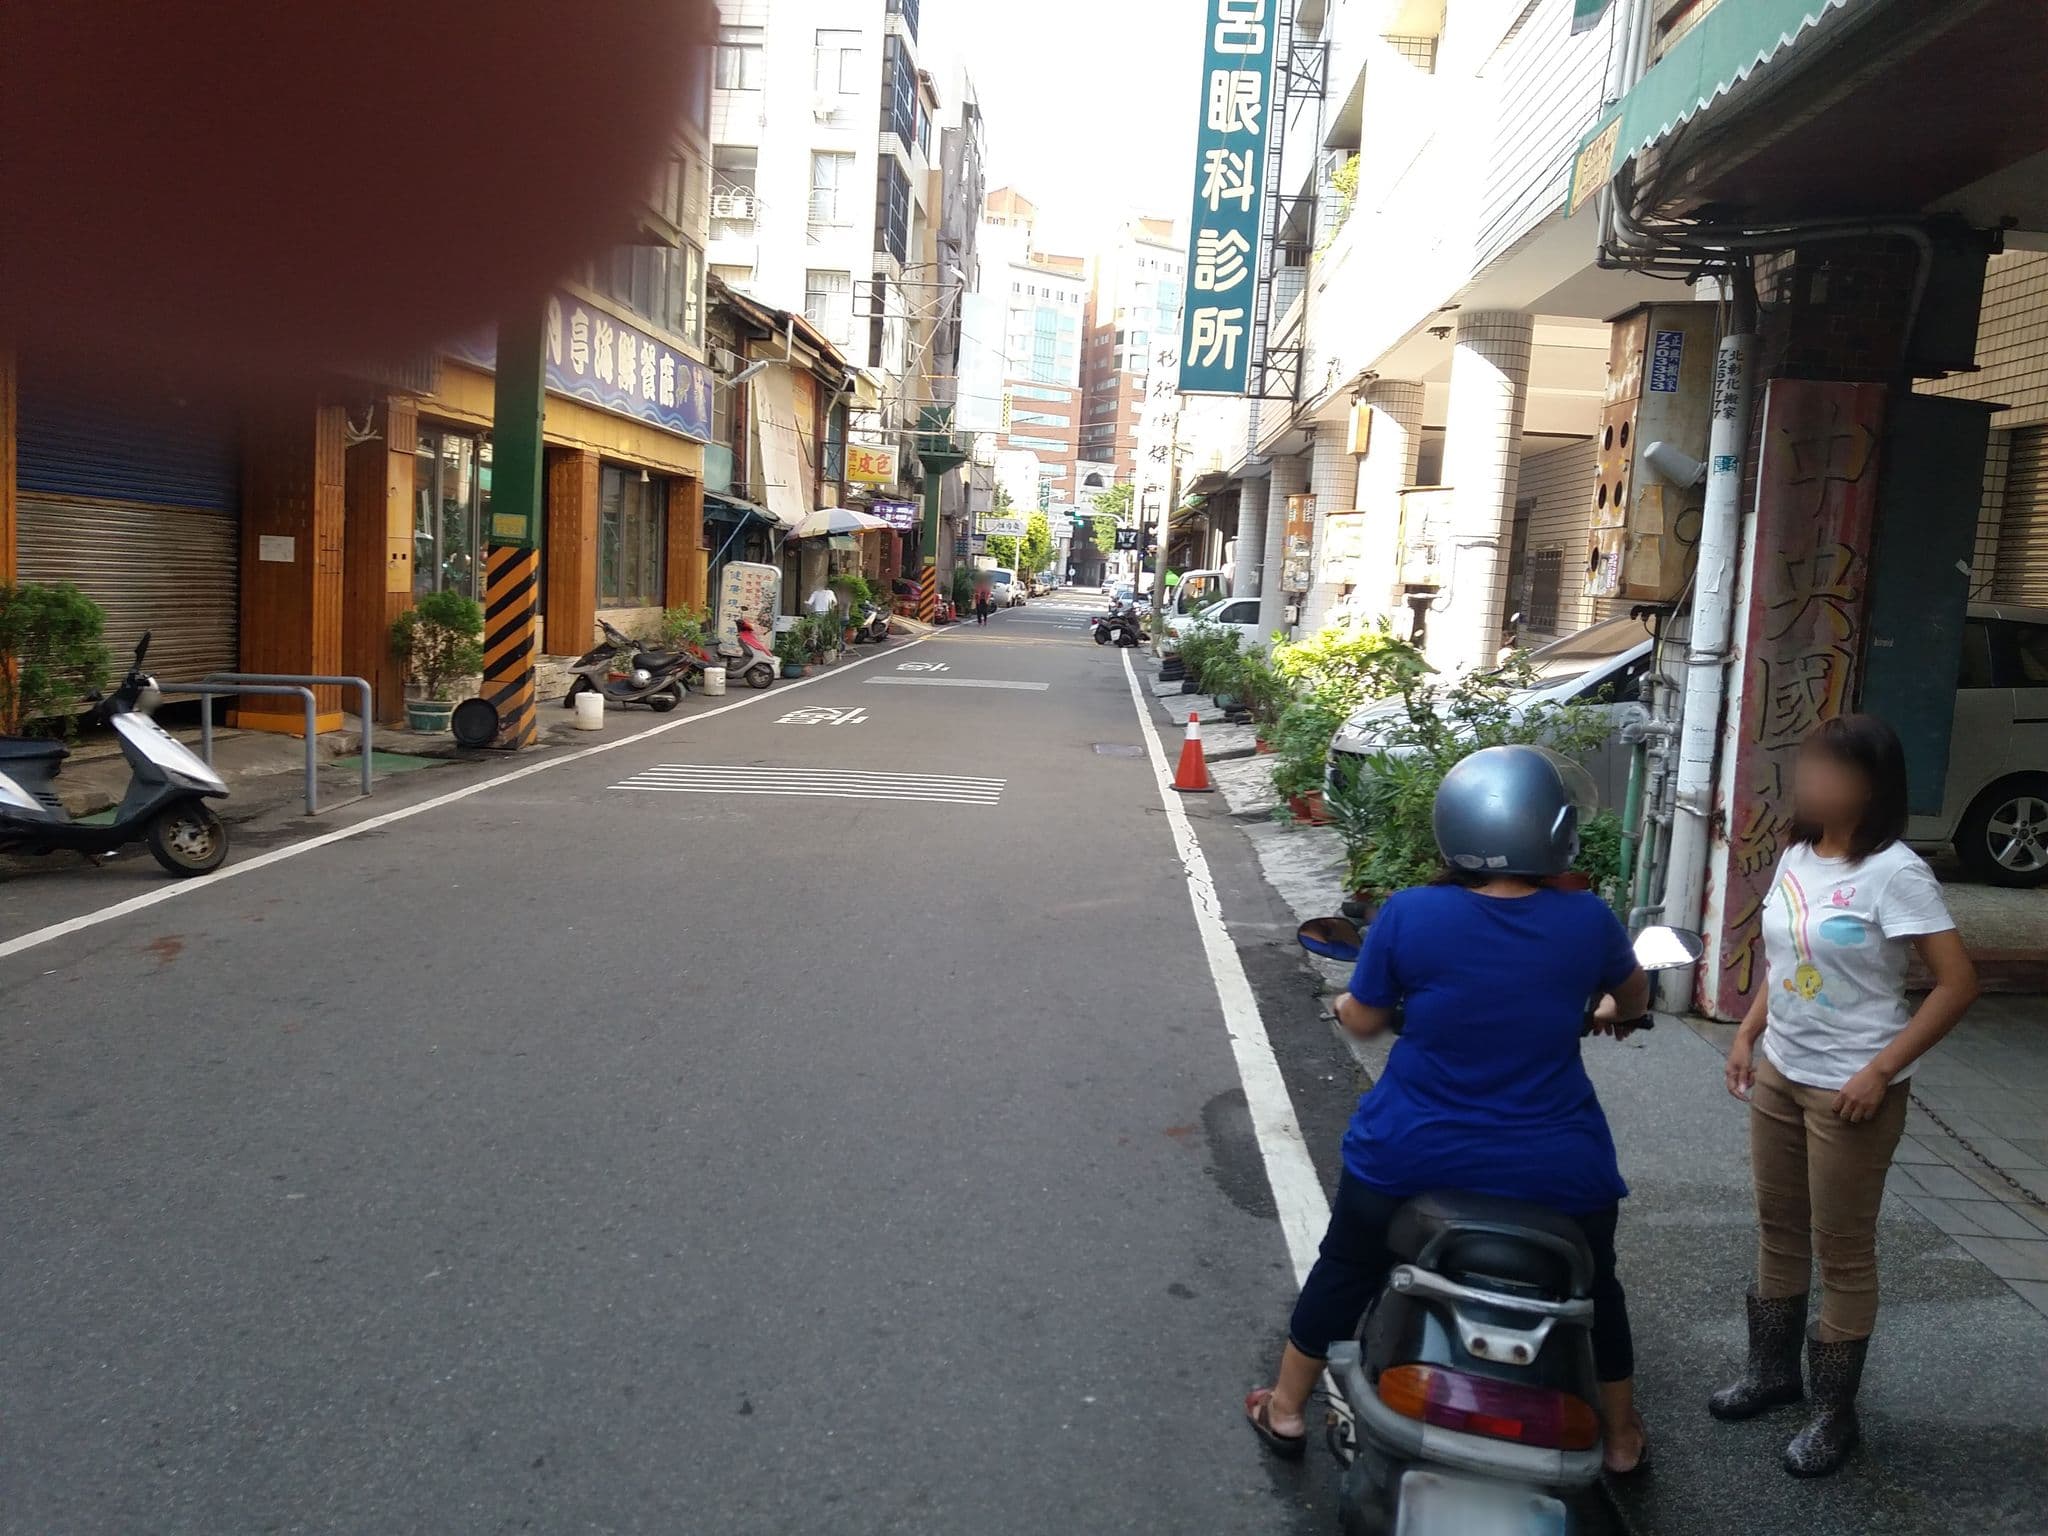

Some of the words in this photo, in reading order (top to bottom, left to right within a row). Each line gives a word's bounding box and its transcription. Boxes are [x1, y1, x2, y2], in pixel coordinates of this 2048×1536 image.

[1722, 350, 1744, 419] 北彰化搬家
